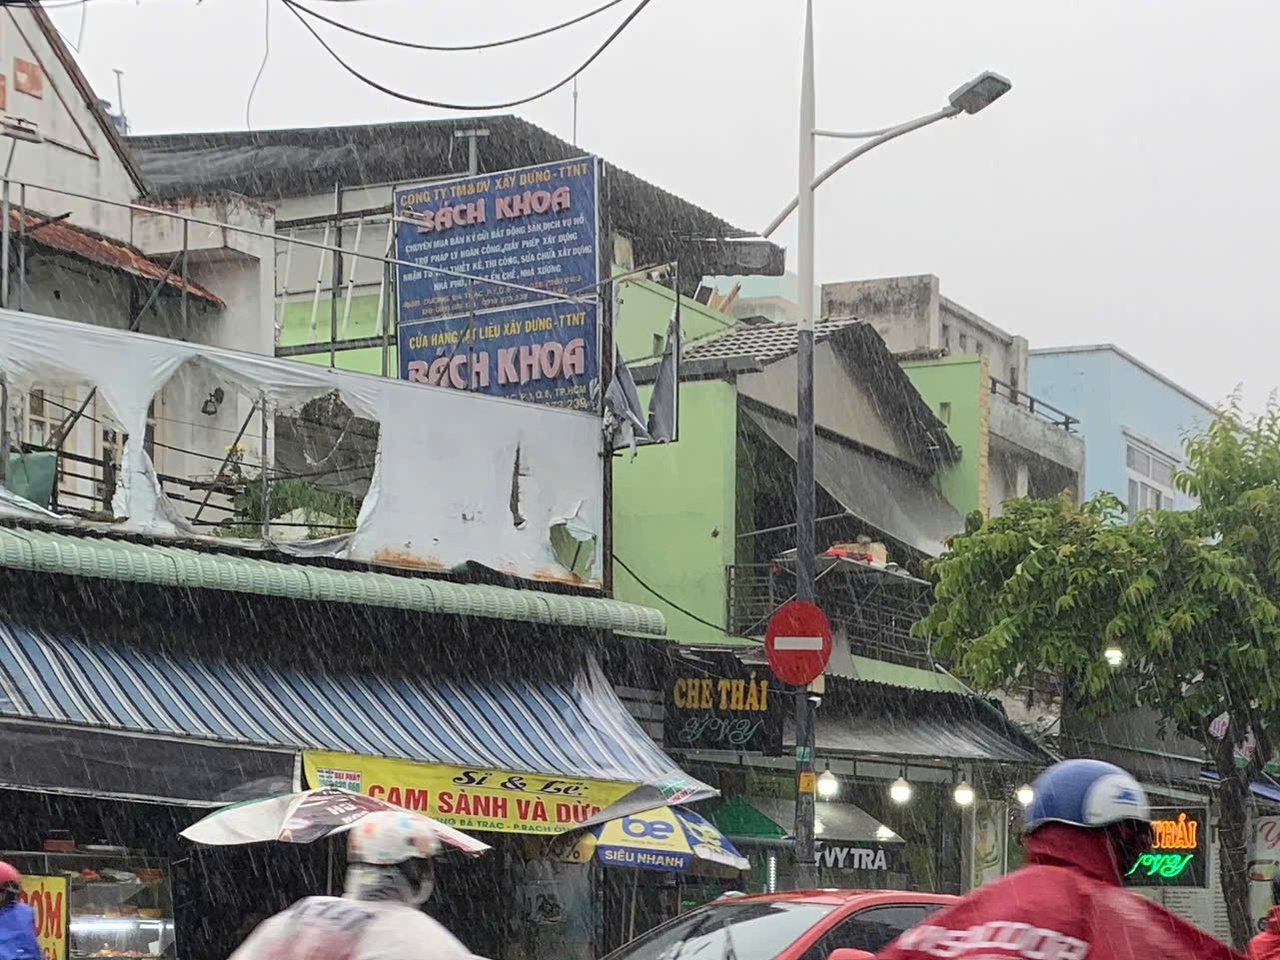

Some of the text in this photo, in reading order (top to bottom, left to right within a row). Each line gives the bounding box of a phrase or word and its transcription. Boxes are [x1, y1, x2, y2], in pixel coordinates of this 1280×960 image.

[417, 186, 570, 233] BÁCH KHOA
[434, 187, 447, 201] TY
[433, 238, 448, 248] MUA
[497, 338, 585, 386] KHOA
[673, 670, 769, 711] CHÈ THÁI
[500, 776, 527, 792] &
[368, 784, 429, 812] CAM
[438, 788, 508, 820] SÀNH
[515, 795, 548, 822] VÀ
[621, 814, 675, 840] be
[1150, 812, 1198, 849] THÁI
[605, 849, 684, 868] SIÊU NHANH
[824, 846, 849, 869] VY
[850, 845, 888, 871] TRÀ
[18, 880, 63, 939] ƠM
